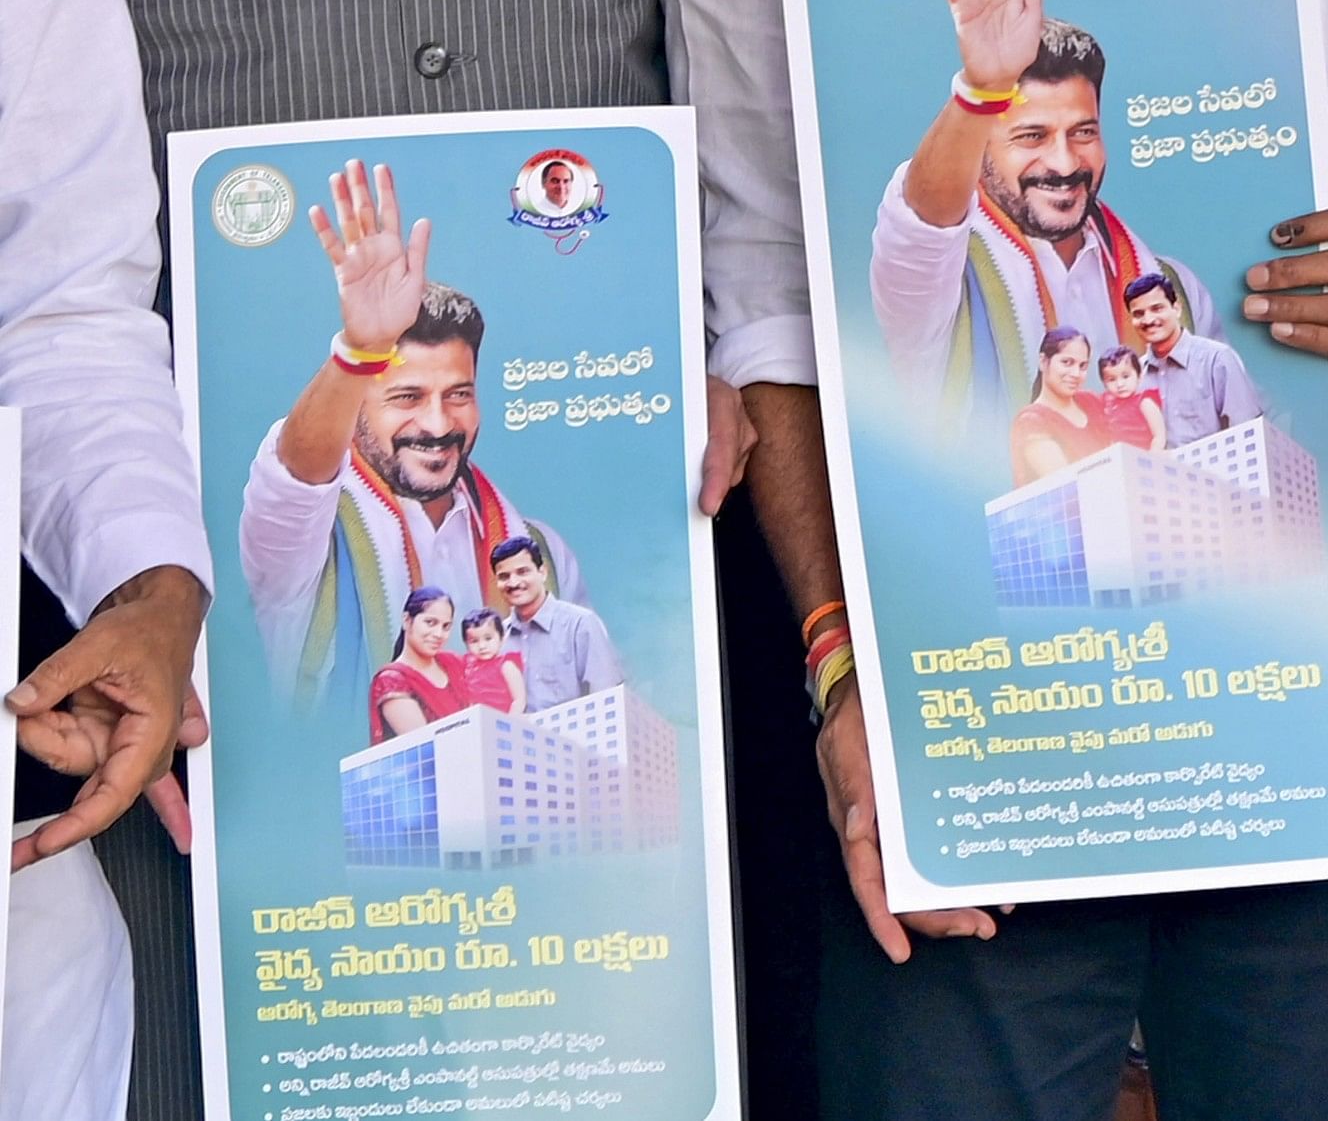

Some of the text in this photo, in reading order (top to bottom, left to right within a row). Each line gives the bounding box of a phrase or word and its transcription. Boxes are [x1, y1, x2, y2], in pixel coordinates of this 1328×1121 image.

[1127, 77, 1276, 126] ప్రజల సేవలో
[1131, 124, 1296, 167] ప్రజా ప్రభుత్వం
[503, 345, 653, 389] ప్రజల సేవలో
[504, 391, 670, 430] ప్రజా ప్రభుత్వం
[911, 622, 1168, 673] రాజీవ్ ఆరోగ్యశ్రీ
[918, 661, 1321, 728] వైద్య సాయం రూ. 10 లక్షలు
[925, 720, 1213, 761] ఆరోగ్య తెలంగాణ వైపు మరో అడుగు
[948, 778, 1015, 803] రాష్ట్రంలోని
[1096, 772, 1161, 788] ఉచితంగా
[1227, 762, 1265, 781] వైద్యం
[952, 812, 982, 829] అన్ని
[982, 806, 1021, 824] రాజీవ్
[1024, 801, 1078, 824] ఆరోగ్యశ్రీ
[1226, 784, 1277, 807] తక్షణమే
[1280, 784, 1326, 799] అమలు
[957, 837, 1005, 857] ప్రజలకు
[1007, 835, 1073, 856] ఇబ్బందులు
[1076, 828, 1131, 845] లేకుండా
[1133, 820, 1196, 841] అమలులో
[1239, 817, 1286, 834] చర్యలు
[252, 886, 516, 934] రాజీవ్ ఆరోగ్యశ్రీ
[255, 929, 669, 990] వైద్య సాయం రూ. 10 లక్షలు
[257, 988, 555, 1025] ఆరోగ్య తెలంగాణ వైపు మరో అడుగు
